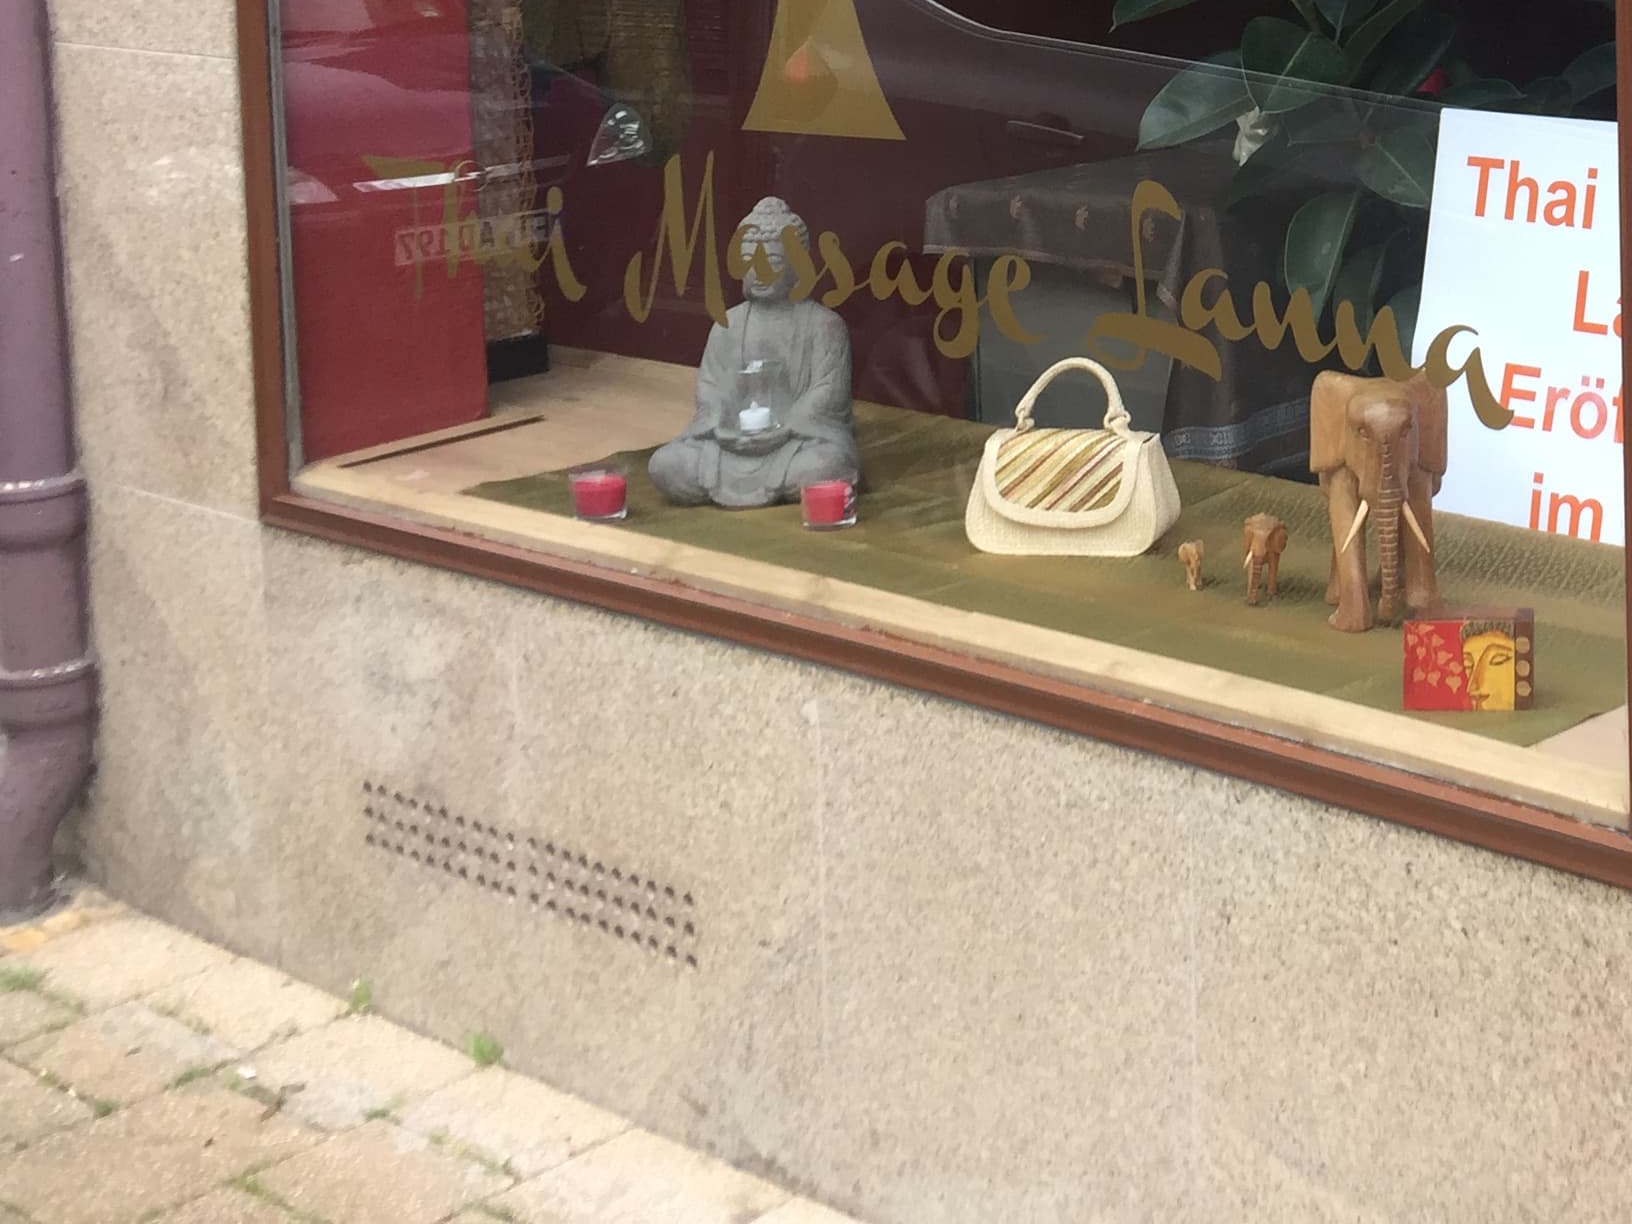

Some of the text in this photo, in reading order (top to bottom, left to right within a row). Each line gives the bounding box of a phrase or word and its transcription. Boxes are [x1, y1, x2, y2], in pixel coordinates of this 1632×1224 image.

[1466, 155, 1598, 230] Thai
[624, 150, 1046, 359] Massage
[1088, 179, 1514, 430] Lanna
[1528, 472, 1604, 544] im
